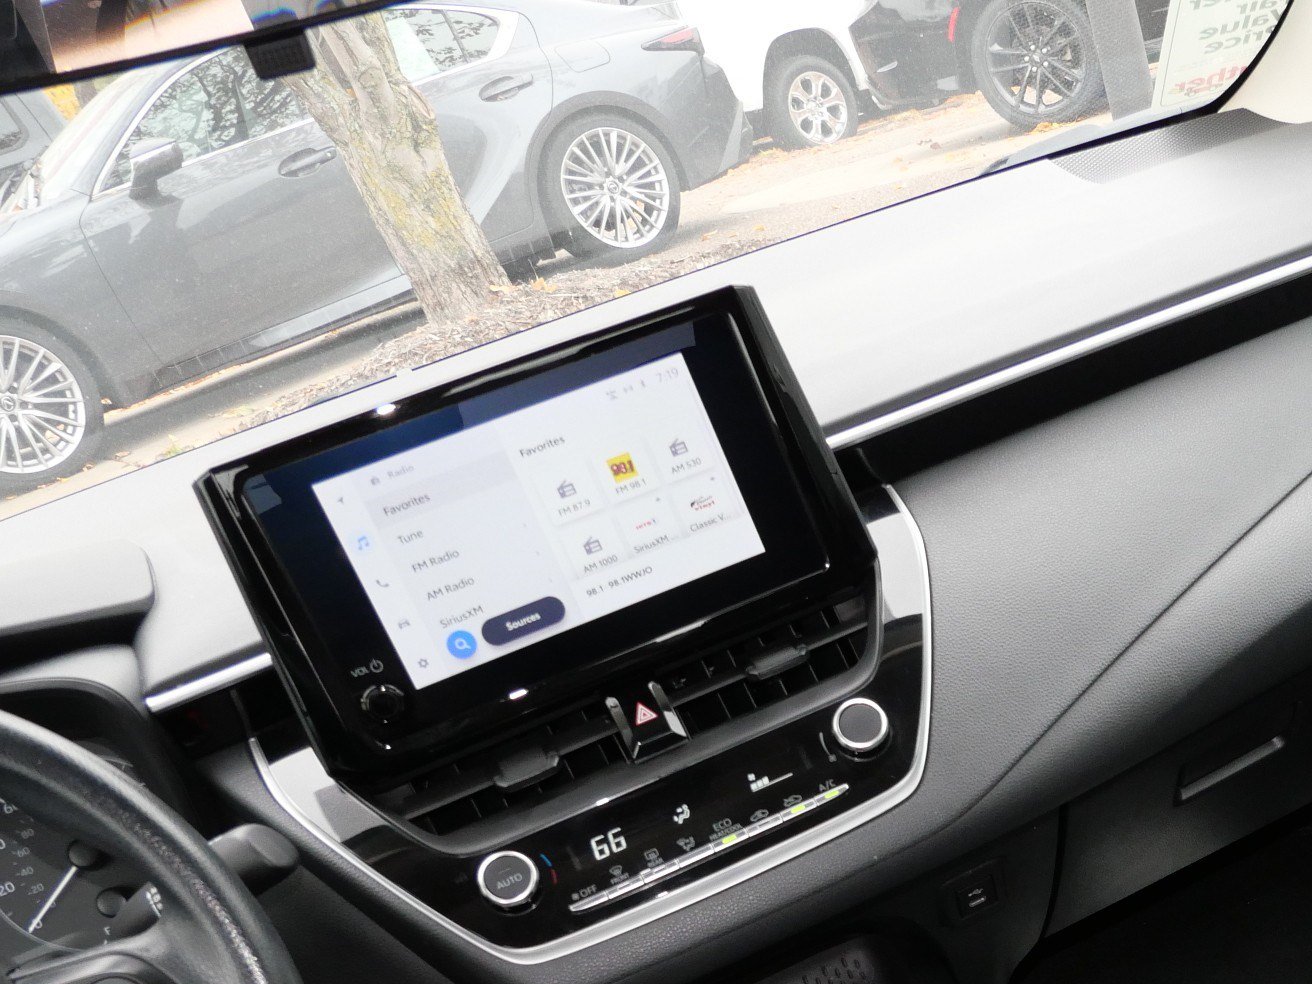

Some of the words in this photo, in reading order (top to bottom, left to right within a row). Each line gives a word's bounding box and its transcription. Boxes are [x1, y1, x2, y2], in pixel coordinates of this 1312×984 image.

[519, 435, 566, 458] Favorites
[387, 463, 414, 480] Radio
[671, 463, 685, 475] AM
[686, 456, 702, 471] 530
[615, 483, 629, 495] FM
[383, 493, 431, 517] Favorites
[558, 505, 572, 517] FM
[690, 516, 717, 533] Classic
[397, 529, 424, 545] Tune
[633, 534, 670, 555] SiriusXM
[411, 560, 428, 573] FM
[429, 549, 460, 565] Radio
[583, 562, 598, 574] AM
[598, 554, 618, 569] 1000
[427, 587, 444, 602] AM
[445, 577, 475, 593] Radio
[440, 604, 484, 629] SiriusXM
[505, 610, 541, 632] Sources
[350, 665, 370, 678] VOL
[818, 779, 836, 792] A/C
[711, 817, 733, 832] ECO
[590, 827, 629, 862] 66
[496, 872, 523, 889] AUTO
[580, 883, 598, 898] OFF
